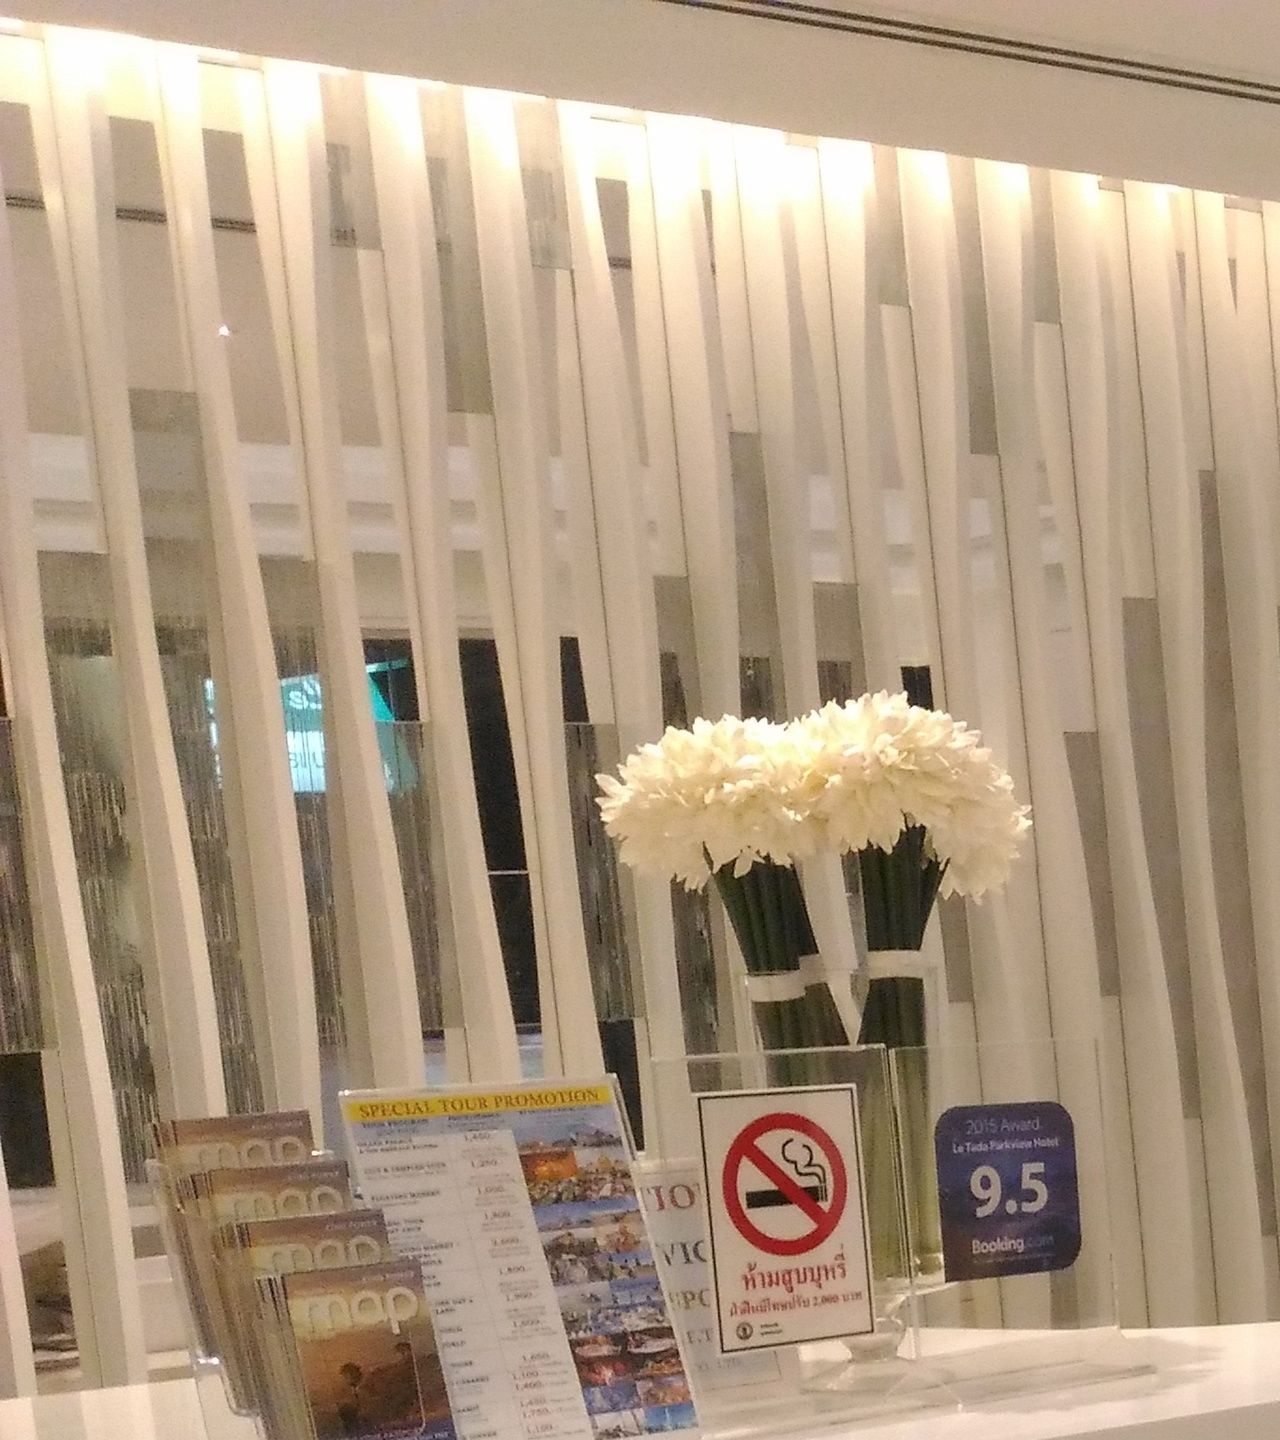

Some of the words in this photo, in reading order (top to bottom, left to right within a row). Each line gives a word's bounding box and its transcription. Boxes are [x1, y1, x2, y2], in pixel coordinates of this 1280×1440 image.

[359, 1098, 434, 1118] SPECIAL
[437, 1096, 488, 1113] TOUR
[496, 1089, 599, 1110] PROMOTION
[1000, 1117, 1040, 1132] Award
[970, 1162, 1048, 1218] 9.5
[742, 1244, 847, 1294] ห้ามสูบบุหรี่
[296, 1287, 419, 1335] map
